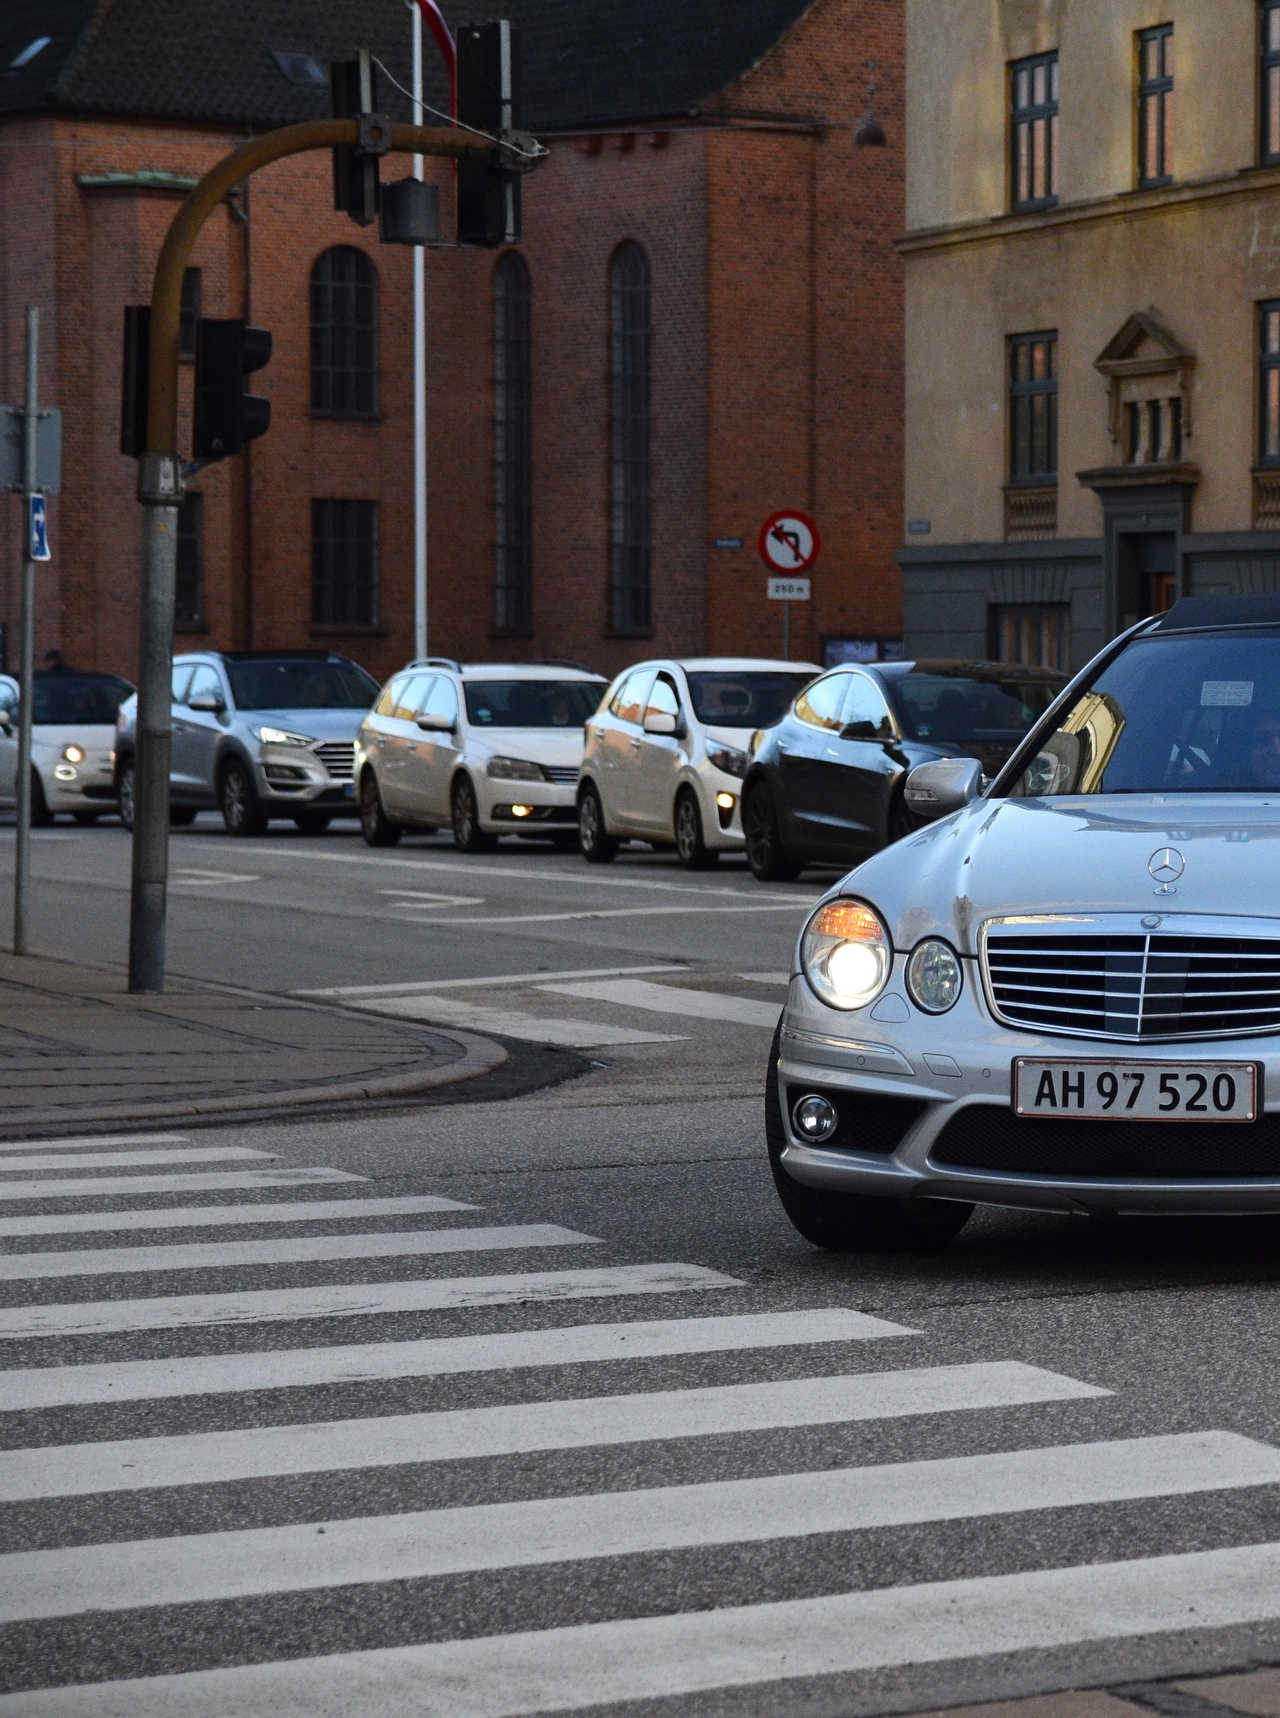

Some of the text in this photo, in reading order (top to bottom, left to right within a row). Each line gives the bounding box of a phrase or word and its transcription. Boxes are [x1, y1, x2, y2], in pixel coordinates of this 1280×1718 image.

[774, 585, 794, 594] 250
[1034, 1070, 1236, 1112] AH 97 520
